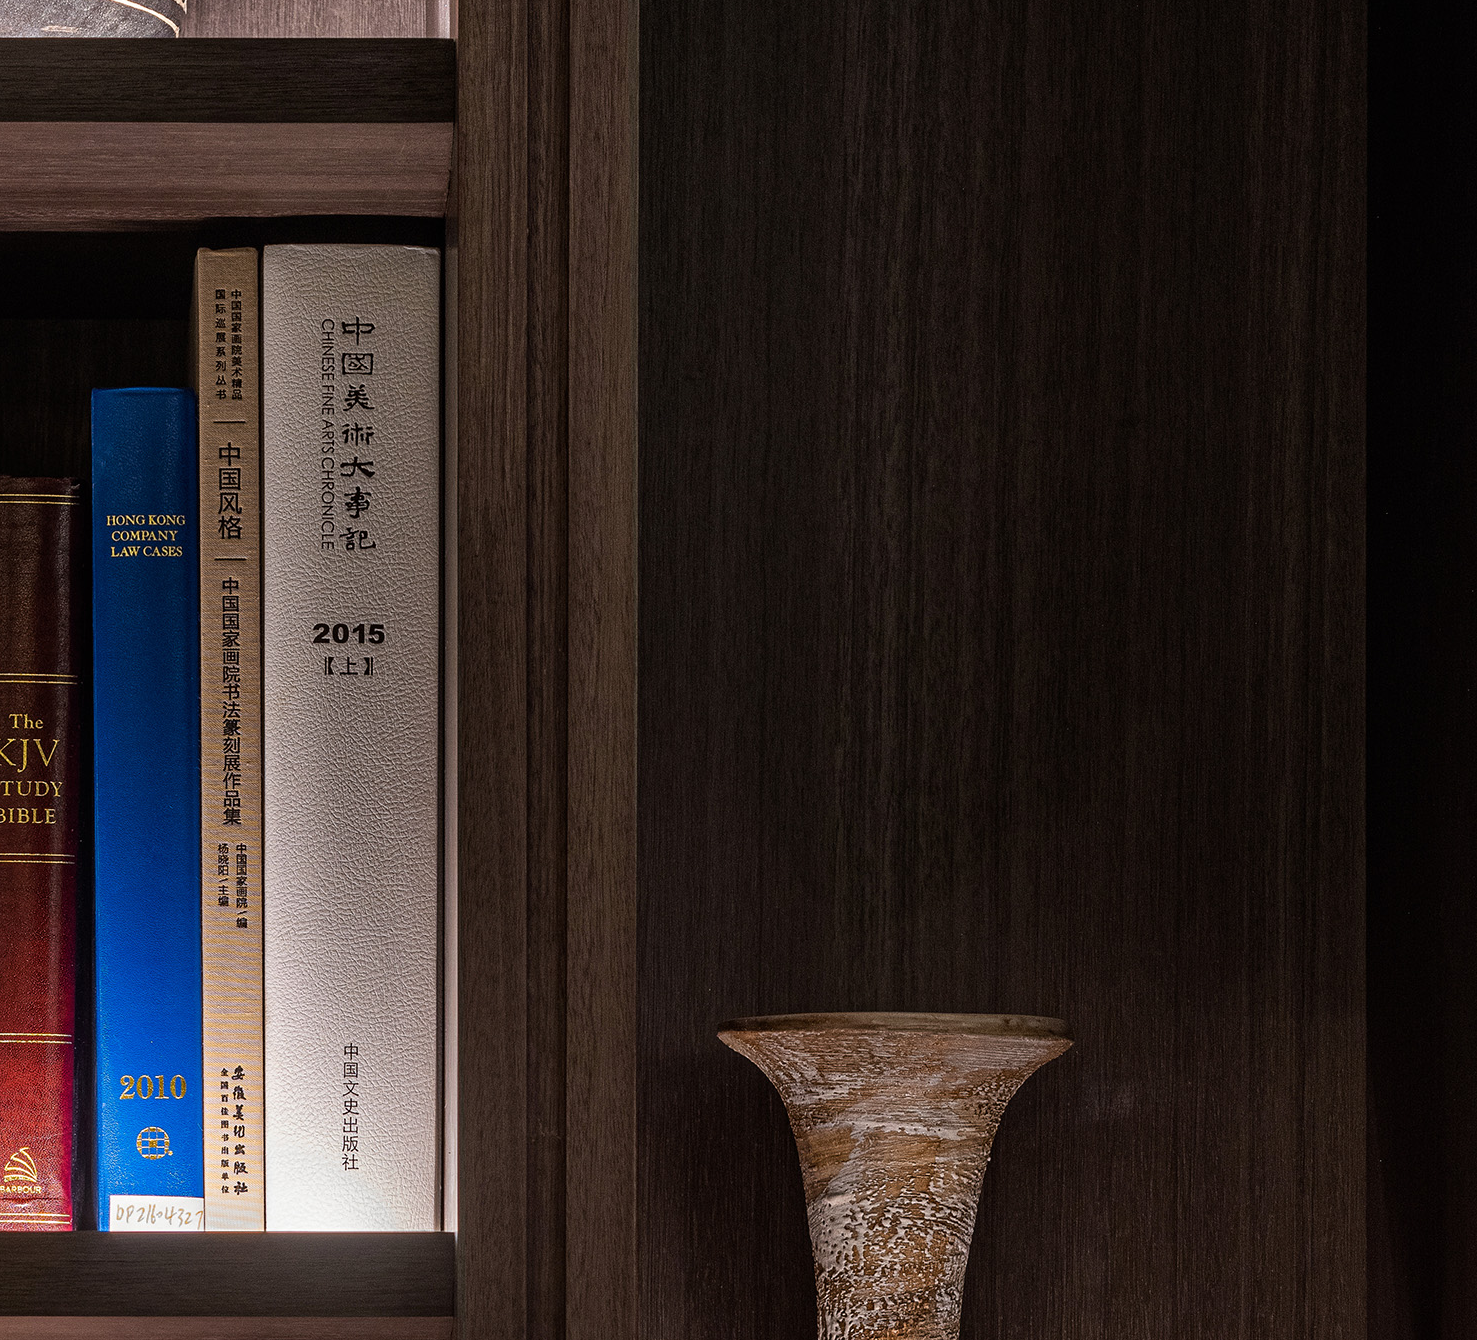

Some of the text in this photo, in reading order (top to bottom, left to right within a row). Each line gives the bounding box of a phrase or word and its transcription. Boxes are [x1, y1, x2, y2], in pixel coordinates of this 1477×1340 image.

[215, 289, 226, 401] 国际巡展系列丛书
[321, 319, 335, 550] CHINESE FINE ARTS CHRONICLE
[340, 315, 376, 551] 中國美術大事記
[106, 515, 186, 527] HONG KONG
[217, 442, 242, 539] 中国风格
[111, 530, 178, 542] COMPANY
[111, 546, 183, 557] LAW CASES
[313, 623, 385, 645] 2015
[8, 713, 43, 730] The
[222, 577, 242, 826] 中国国家画院书法篆刻展作品集
[119, 1074, 187, 1100] 2010
[343, 1043, 360, 1171] 中国文史出版社
